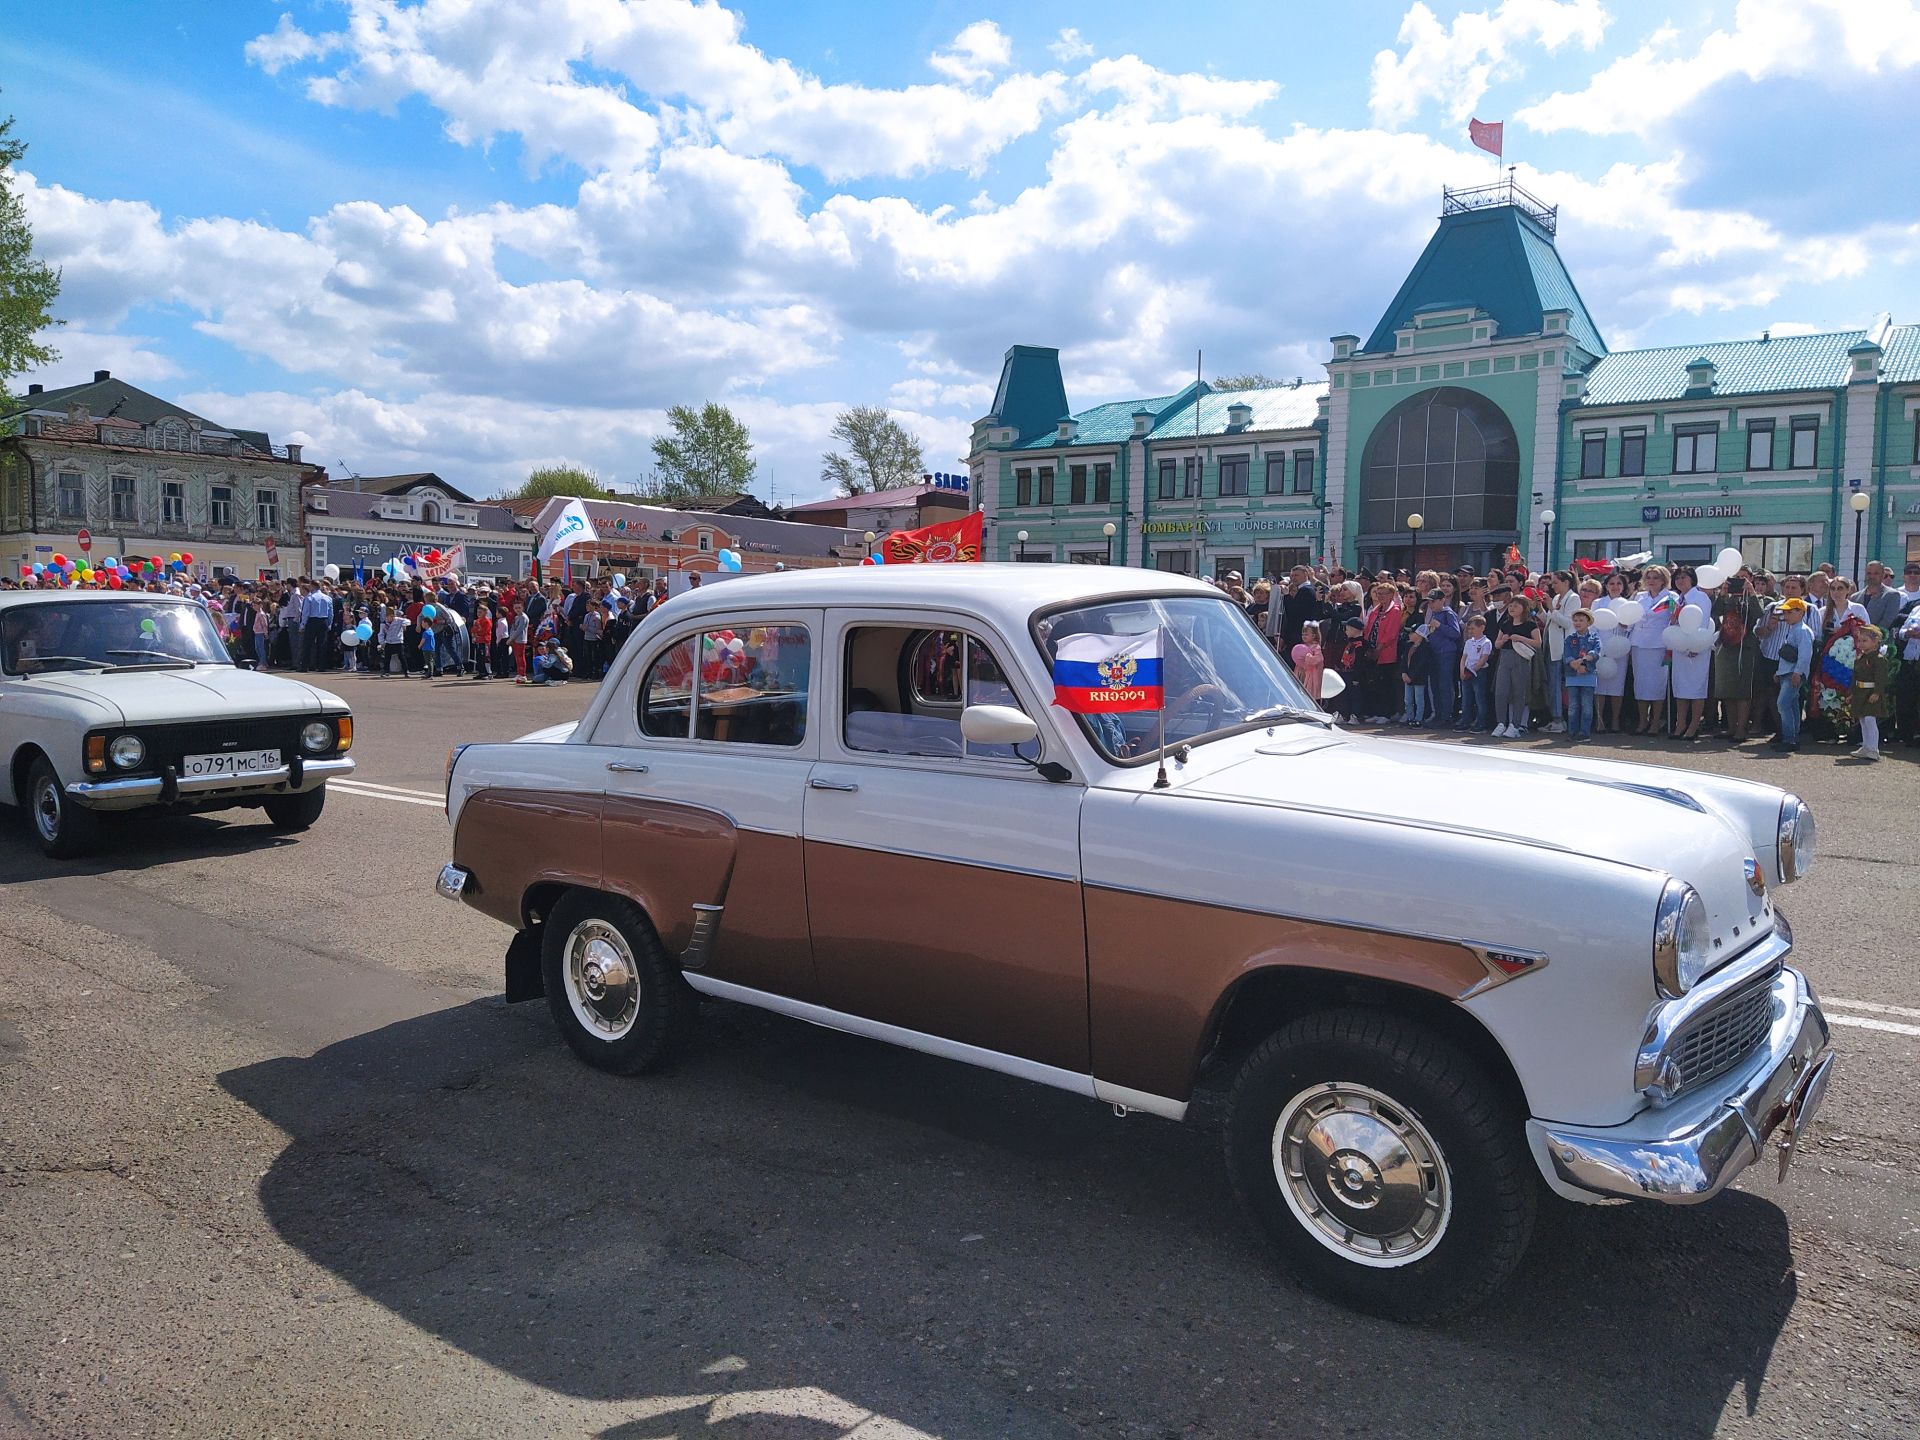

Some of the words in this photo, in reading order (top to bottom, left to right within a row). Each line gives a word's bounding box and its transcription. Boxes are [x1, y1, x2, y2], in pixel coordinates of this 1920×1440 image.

[935, 472, 970, 492] SAMS
[1665, 507, 1702, 519] ПОЧТА
[1707, 505, 1740, 517] БАНК
[592, 518, 615, 529] ТЕКА
[627, 521, 648, 531] ВИТА
[1233, 520, 1274, 531] LOUNGE
[1277, 519, 1321, 530] MARKET
[354, 543, 380, 555] café
[475, 553, 503, 565] кафе
[260, 752, 275, 764] 16
[1495, 954, 1526, 964] 403
